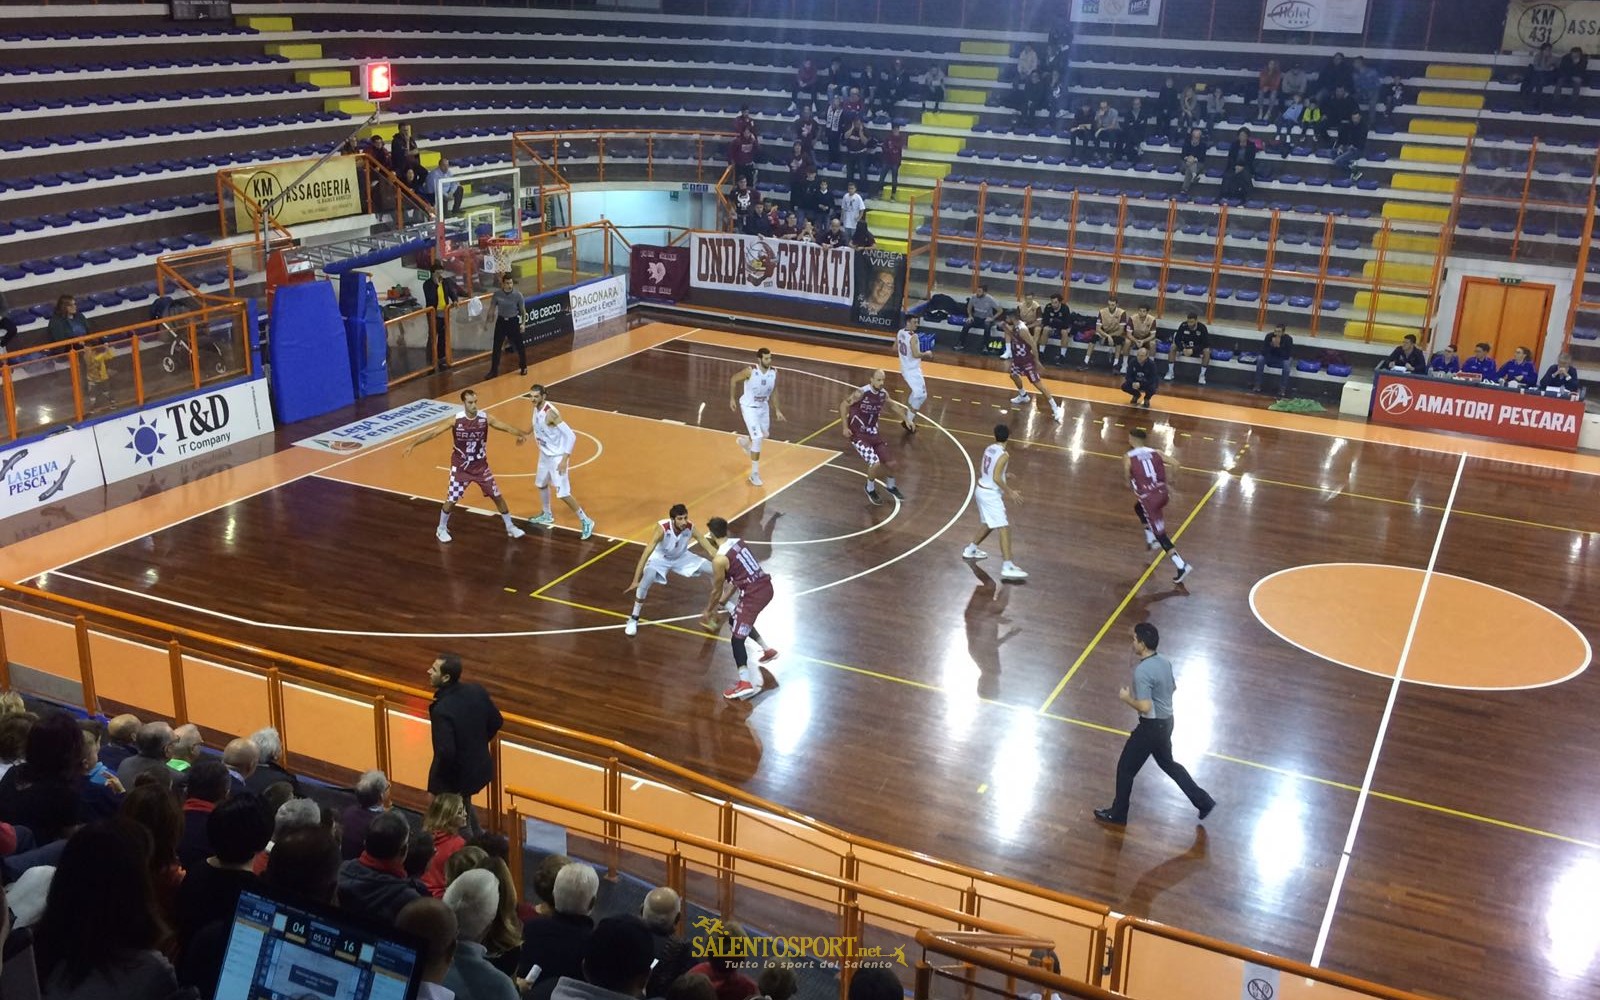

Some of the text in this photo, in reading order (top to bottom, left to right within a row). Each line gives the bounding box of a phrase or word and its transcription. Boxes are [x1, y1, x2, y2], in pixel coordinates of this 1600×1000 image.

[1530, 8, 1556, 25] KM
[1567, 20, 1600, 36] ASS
[372, 65, 389, 92] 6
[253, 177, 273, 198] KM
[286, 178, 351, 203] ASSAGGERIA
[776, 241, 851, 298] GRANATA
[869, 257, 896, 269] VIVE
[570, 286, 619, 309] DRAGONARA
[530, 308, 539, 321] de
[166, 394, 230, 442] T&D
[352, 404, 454, 442] Femminile
[378, 400, 436, 422] Basket
[1414, 394, 1576, 434] AMATORI PESCARA
[177, 432, 231, 455] IT Company
[7, 460, 59, 485] LA SELVA
[8, 476, 48, 496] PESCA
[735, 546, 760, 576] 10
[292, 921, 305, 934] 04
[343, 939, 355, 952] 16
